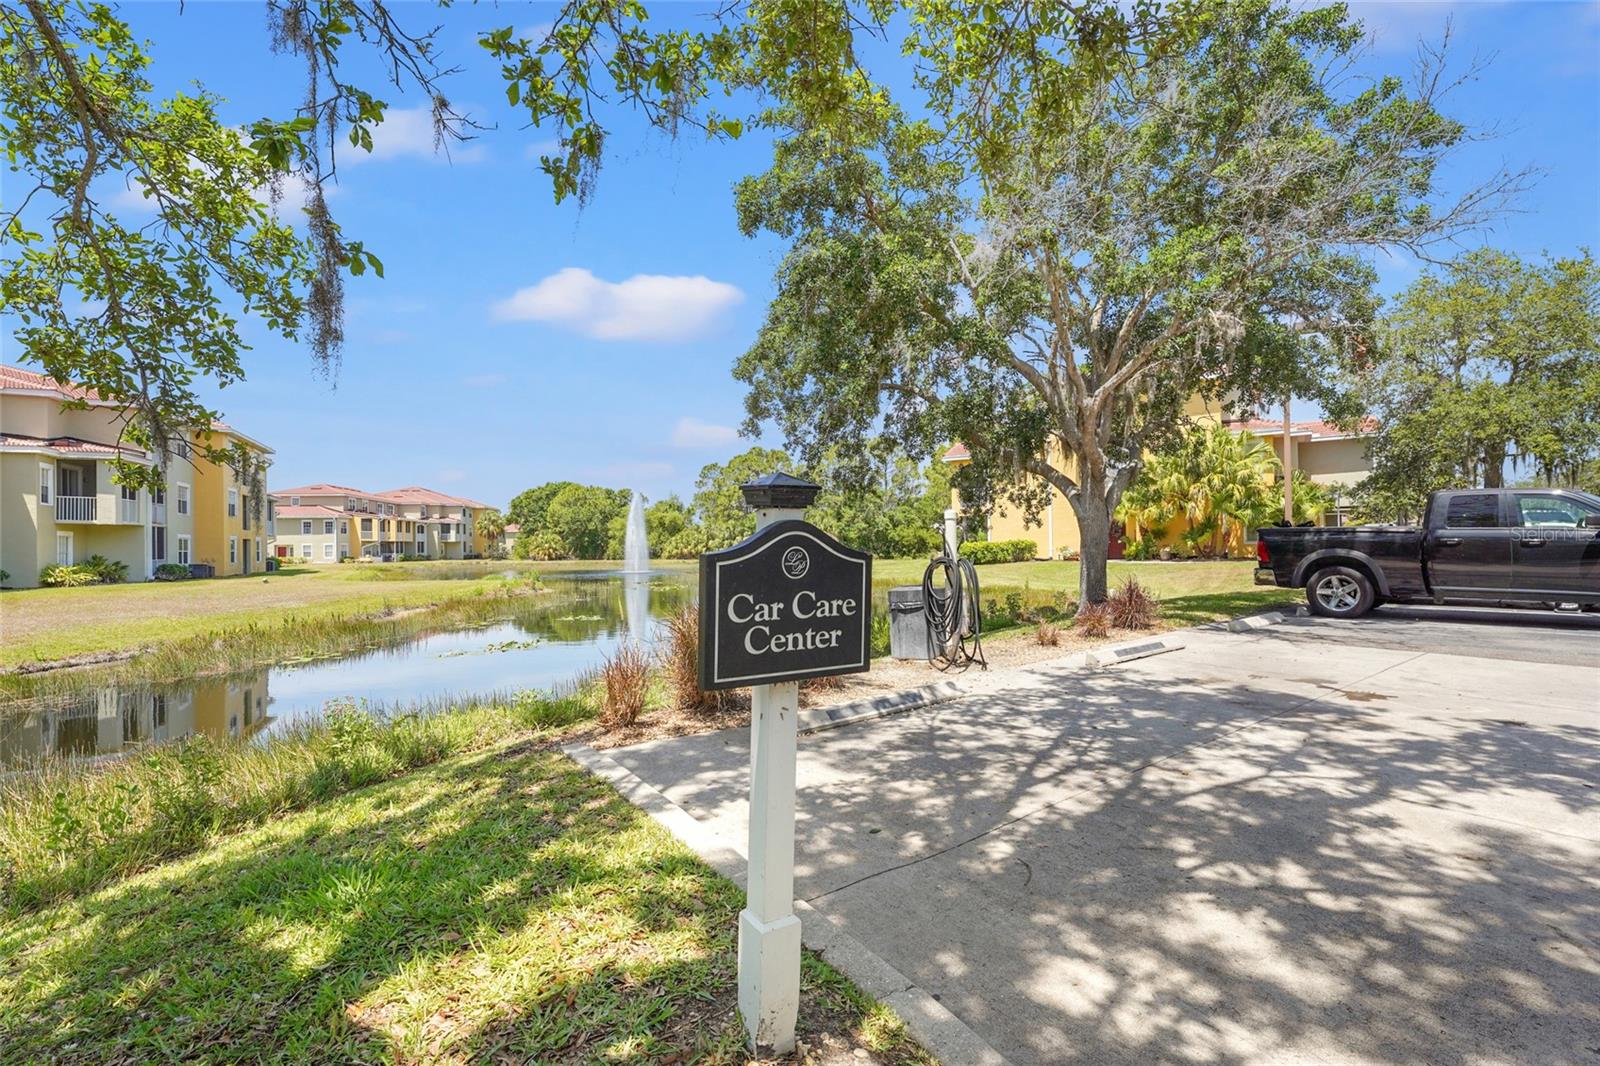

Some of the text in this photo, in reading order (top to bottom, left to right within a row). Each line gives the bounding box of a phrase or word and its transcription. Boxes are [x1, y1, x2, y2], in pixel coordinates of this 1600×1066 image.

[727, 590, 856, 624] Car Care
[744, 625, 842, 655] Center
